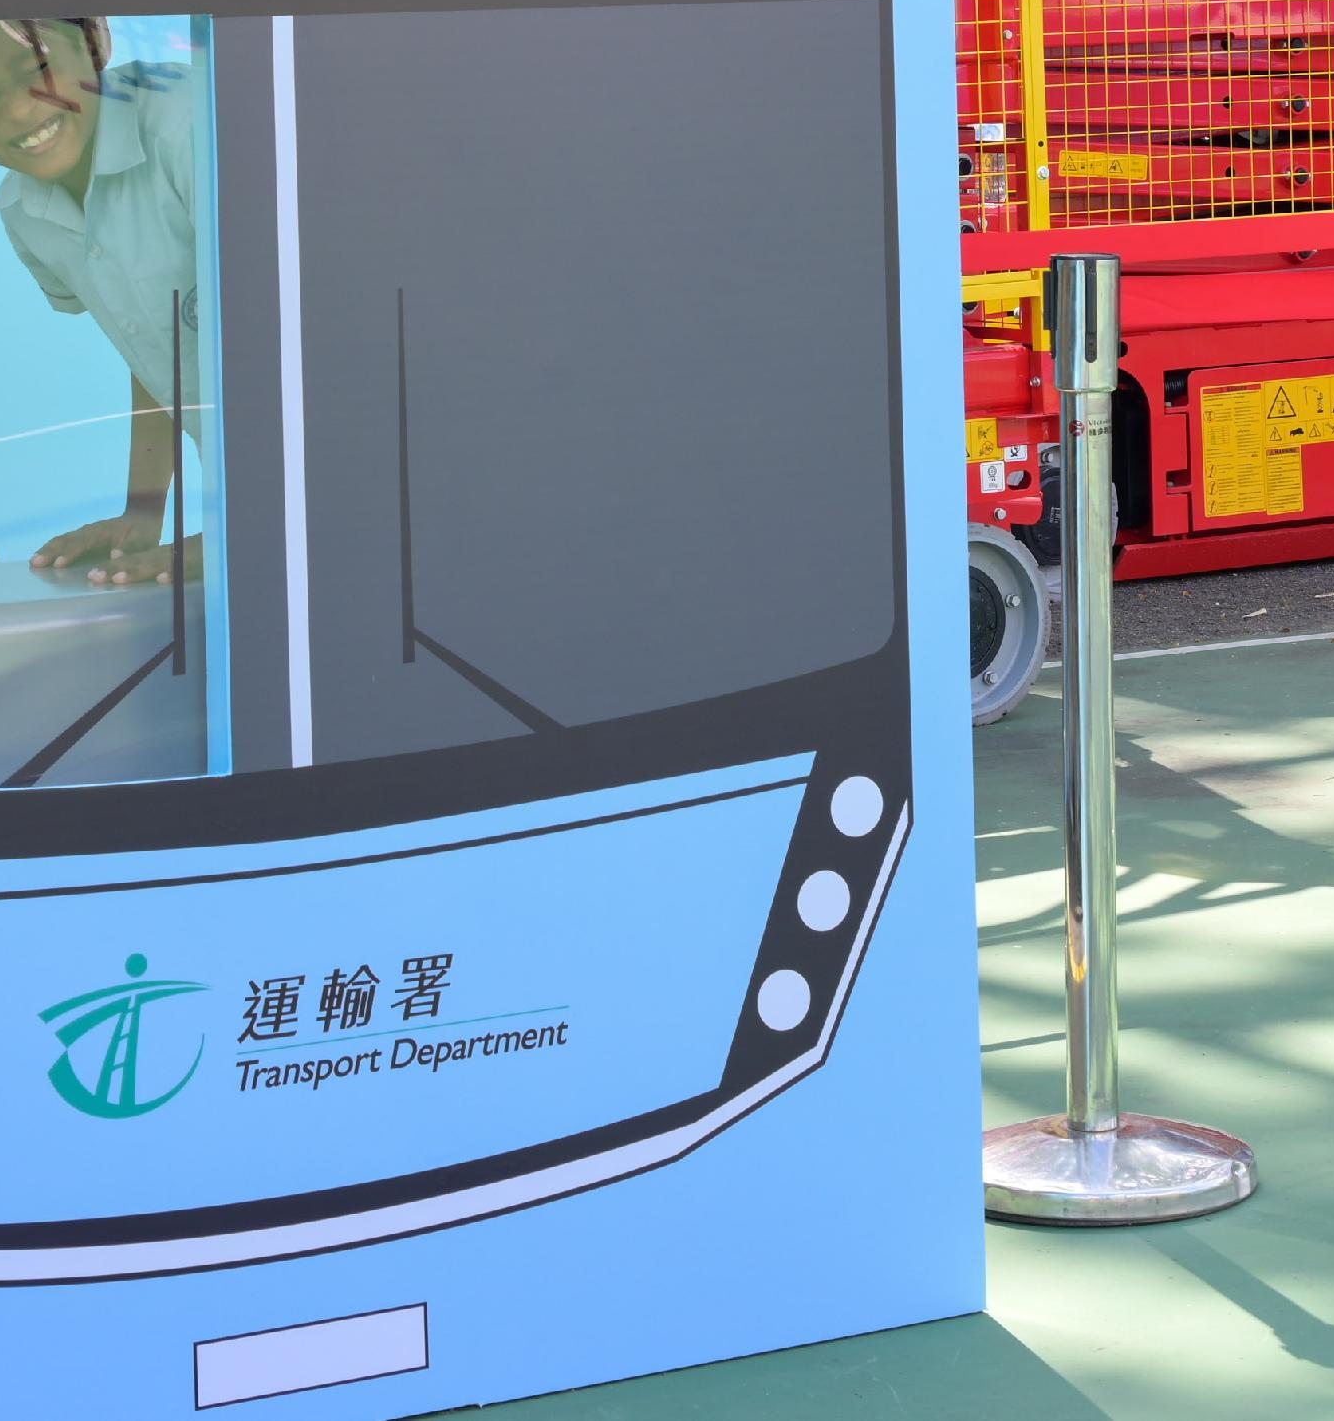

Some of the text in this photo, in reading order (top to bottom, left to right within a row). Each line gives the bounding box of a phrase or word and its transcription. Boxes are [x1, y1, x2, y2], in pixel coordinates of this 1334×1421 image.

[237, 953, 453, 1044] 運輸署
[236, 1020, 569, 1092] Transport Department
